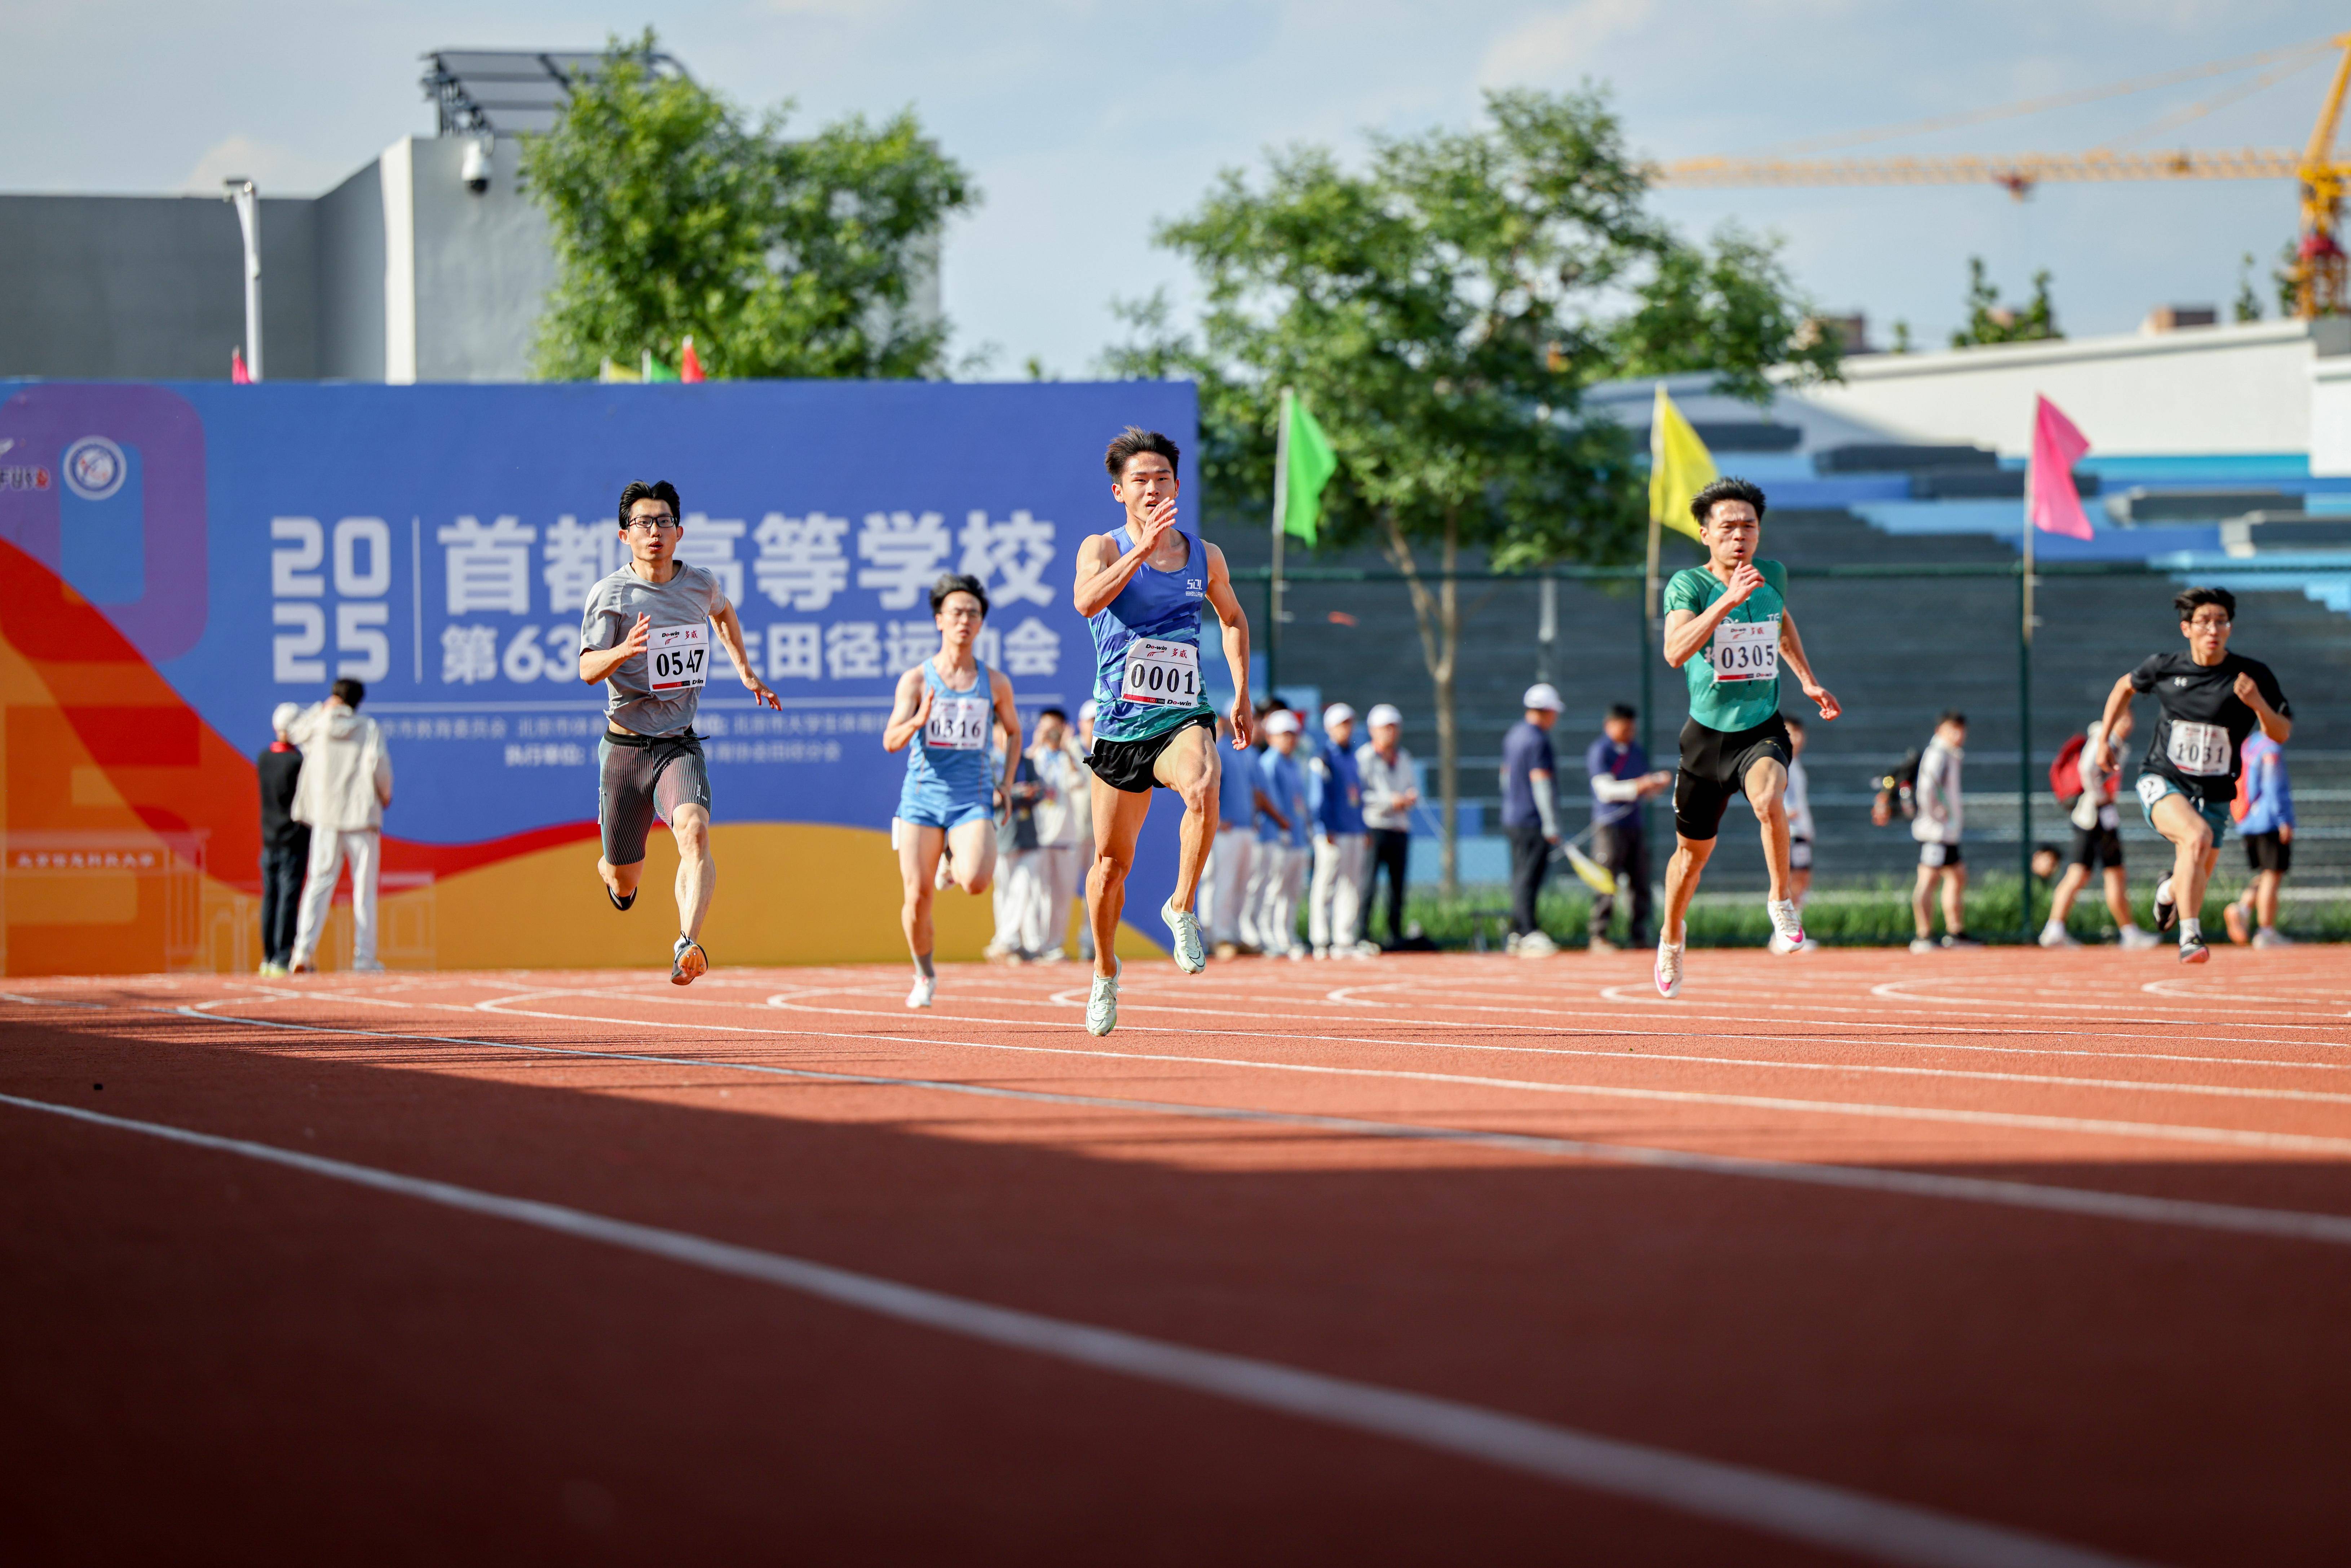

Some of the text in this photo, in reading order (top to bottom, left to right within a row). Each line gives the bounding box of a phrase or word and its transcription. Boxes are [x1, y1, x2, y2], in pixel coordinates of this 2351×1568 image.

[271, 516, 390, 597] 20
[273, 602, 390, 684] 25
[685, 630, 698, 640] 多威
[656, 649, 704, 677] 0547
[1171, 648, 1187, 659] 多威
[1722, 644, 1774, 669] 0305
[1131, 663, 1195, 695] 0001
[931, 719, 981, 738] 0316
[2176, 743, 2223, 765] 1031
